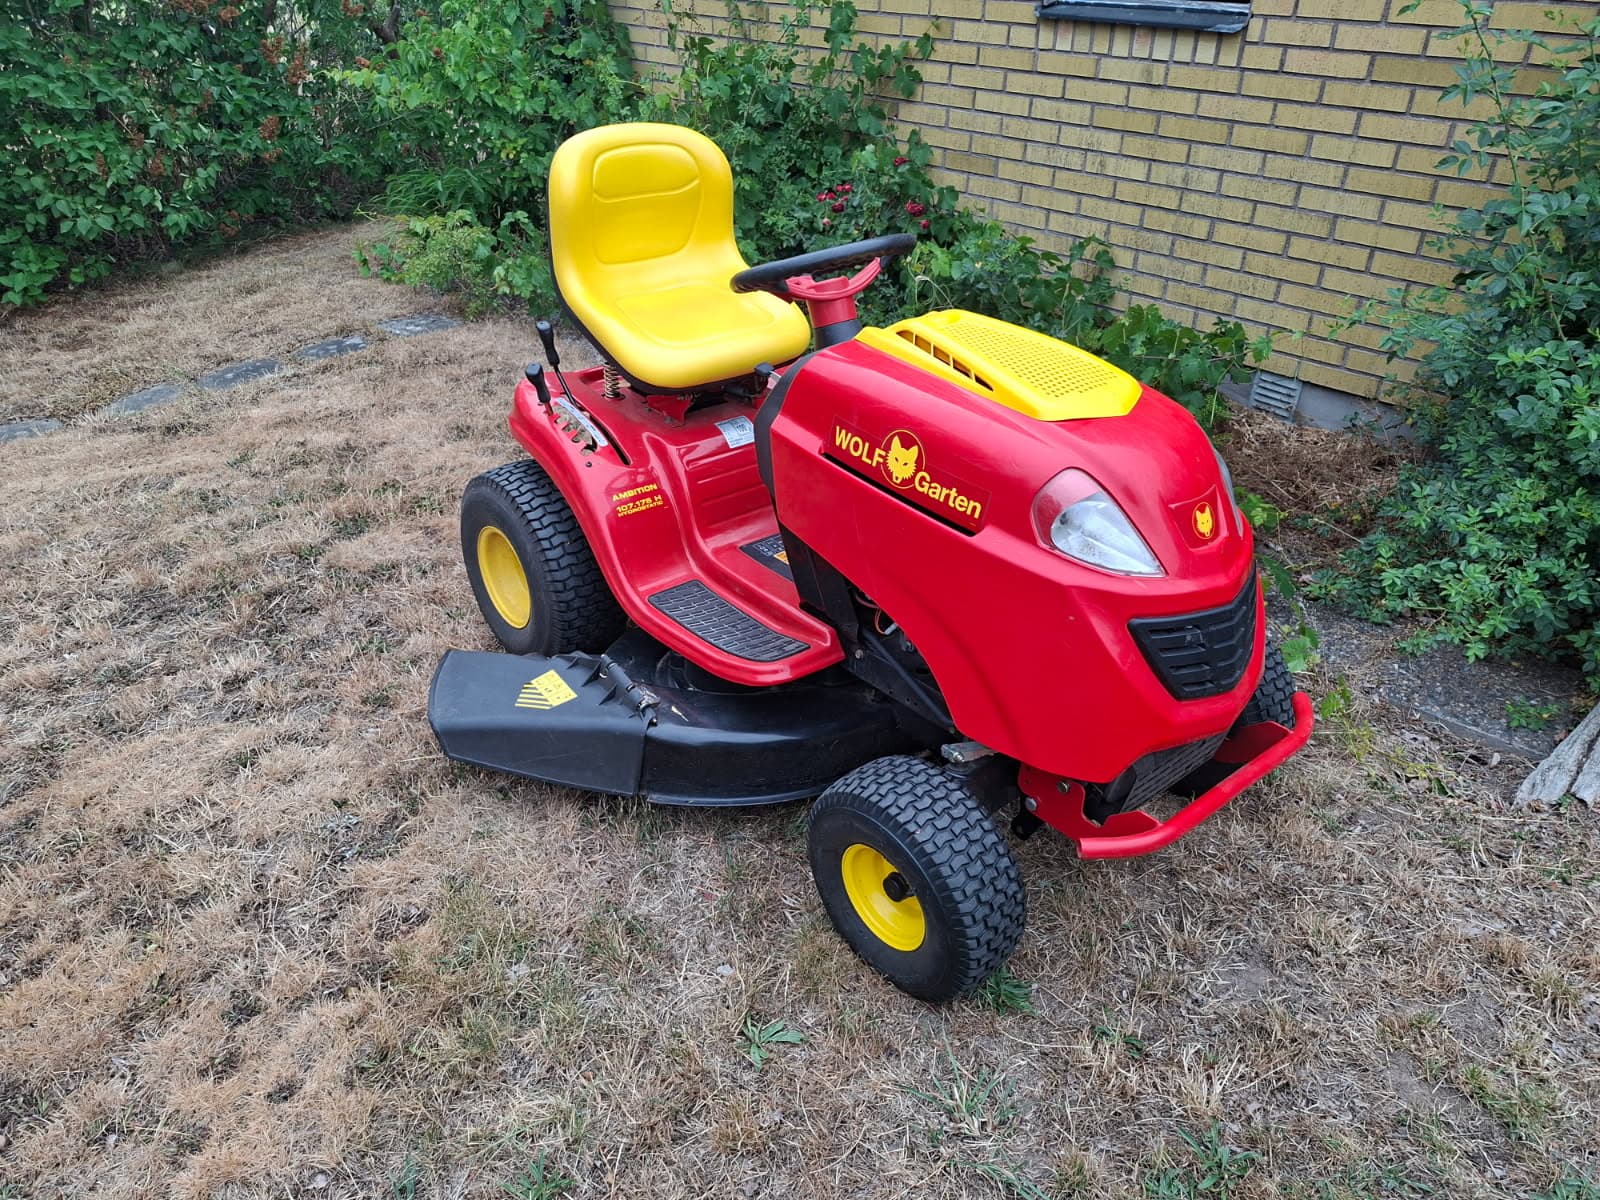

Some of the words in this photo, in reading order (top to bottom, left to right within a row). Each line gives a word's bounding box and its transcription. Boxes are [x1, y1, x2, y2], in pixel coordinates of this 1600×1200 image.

[834, 425, 887, 468] WOLF
[914, 471, 982, 519] Garten
[612, 483, 658, 502] AMBITION
[653, 494, 663, 502] H
